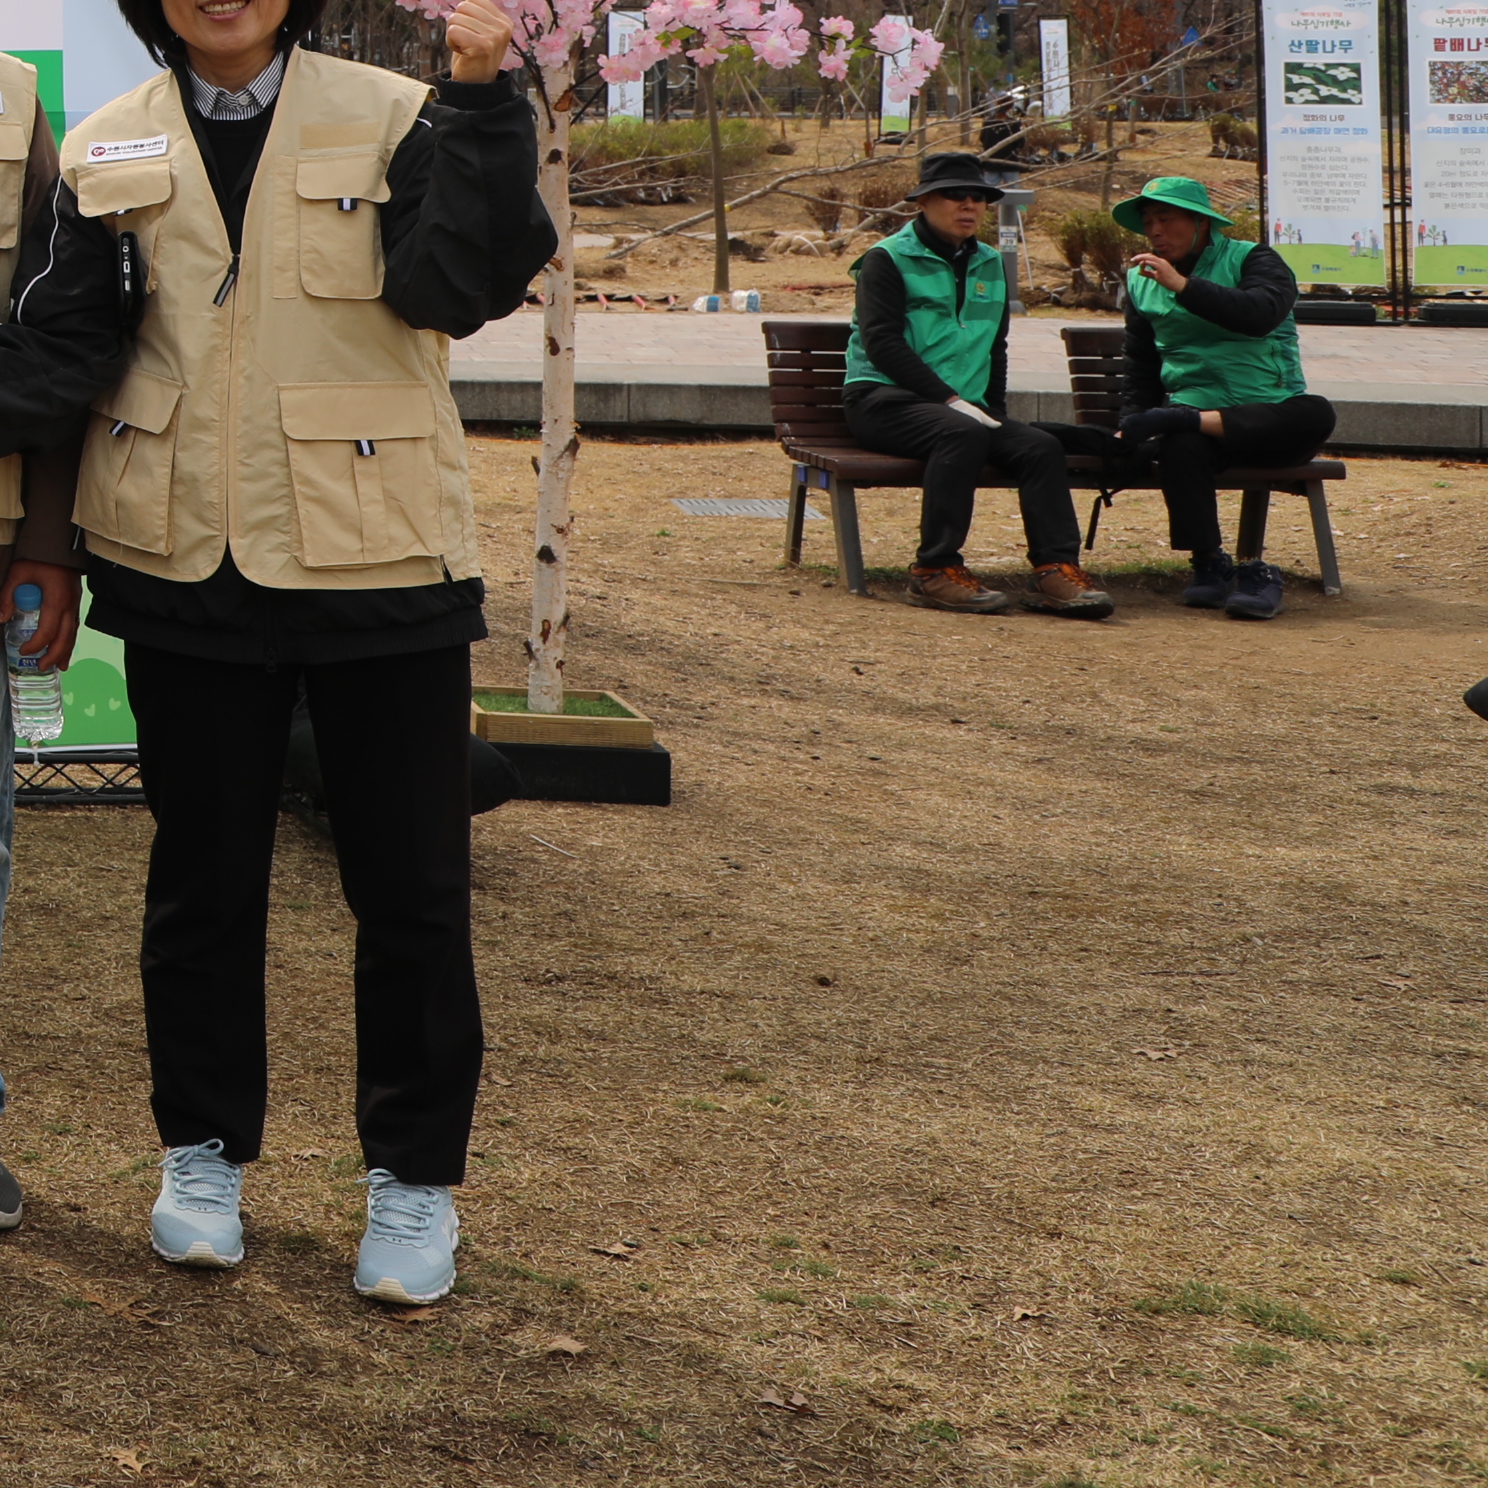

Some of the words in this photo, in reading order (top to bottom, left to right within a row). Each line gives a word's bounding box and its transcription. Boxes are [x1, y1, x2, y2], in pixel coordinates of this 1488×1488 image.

[1290, 19, 1352, 30] 나무심기행사
[1435, 17, 1488, 28] 나무심기행
[1288, 39, 1354, 54] 산딸나무
